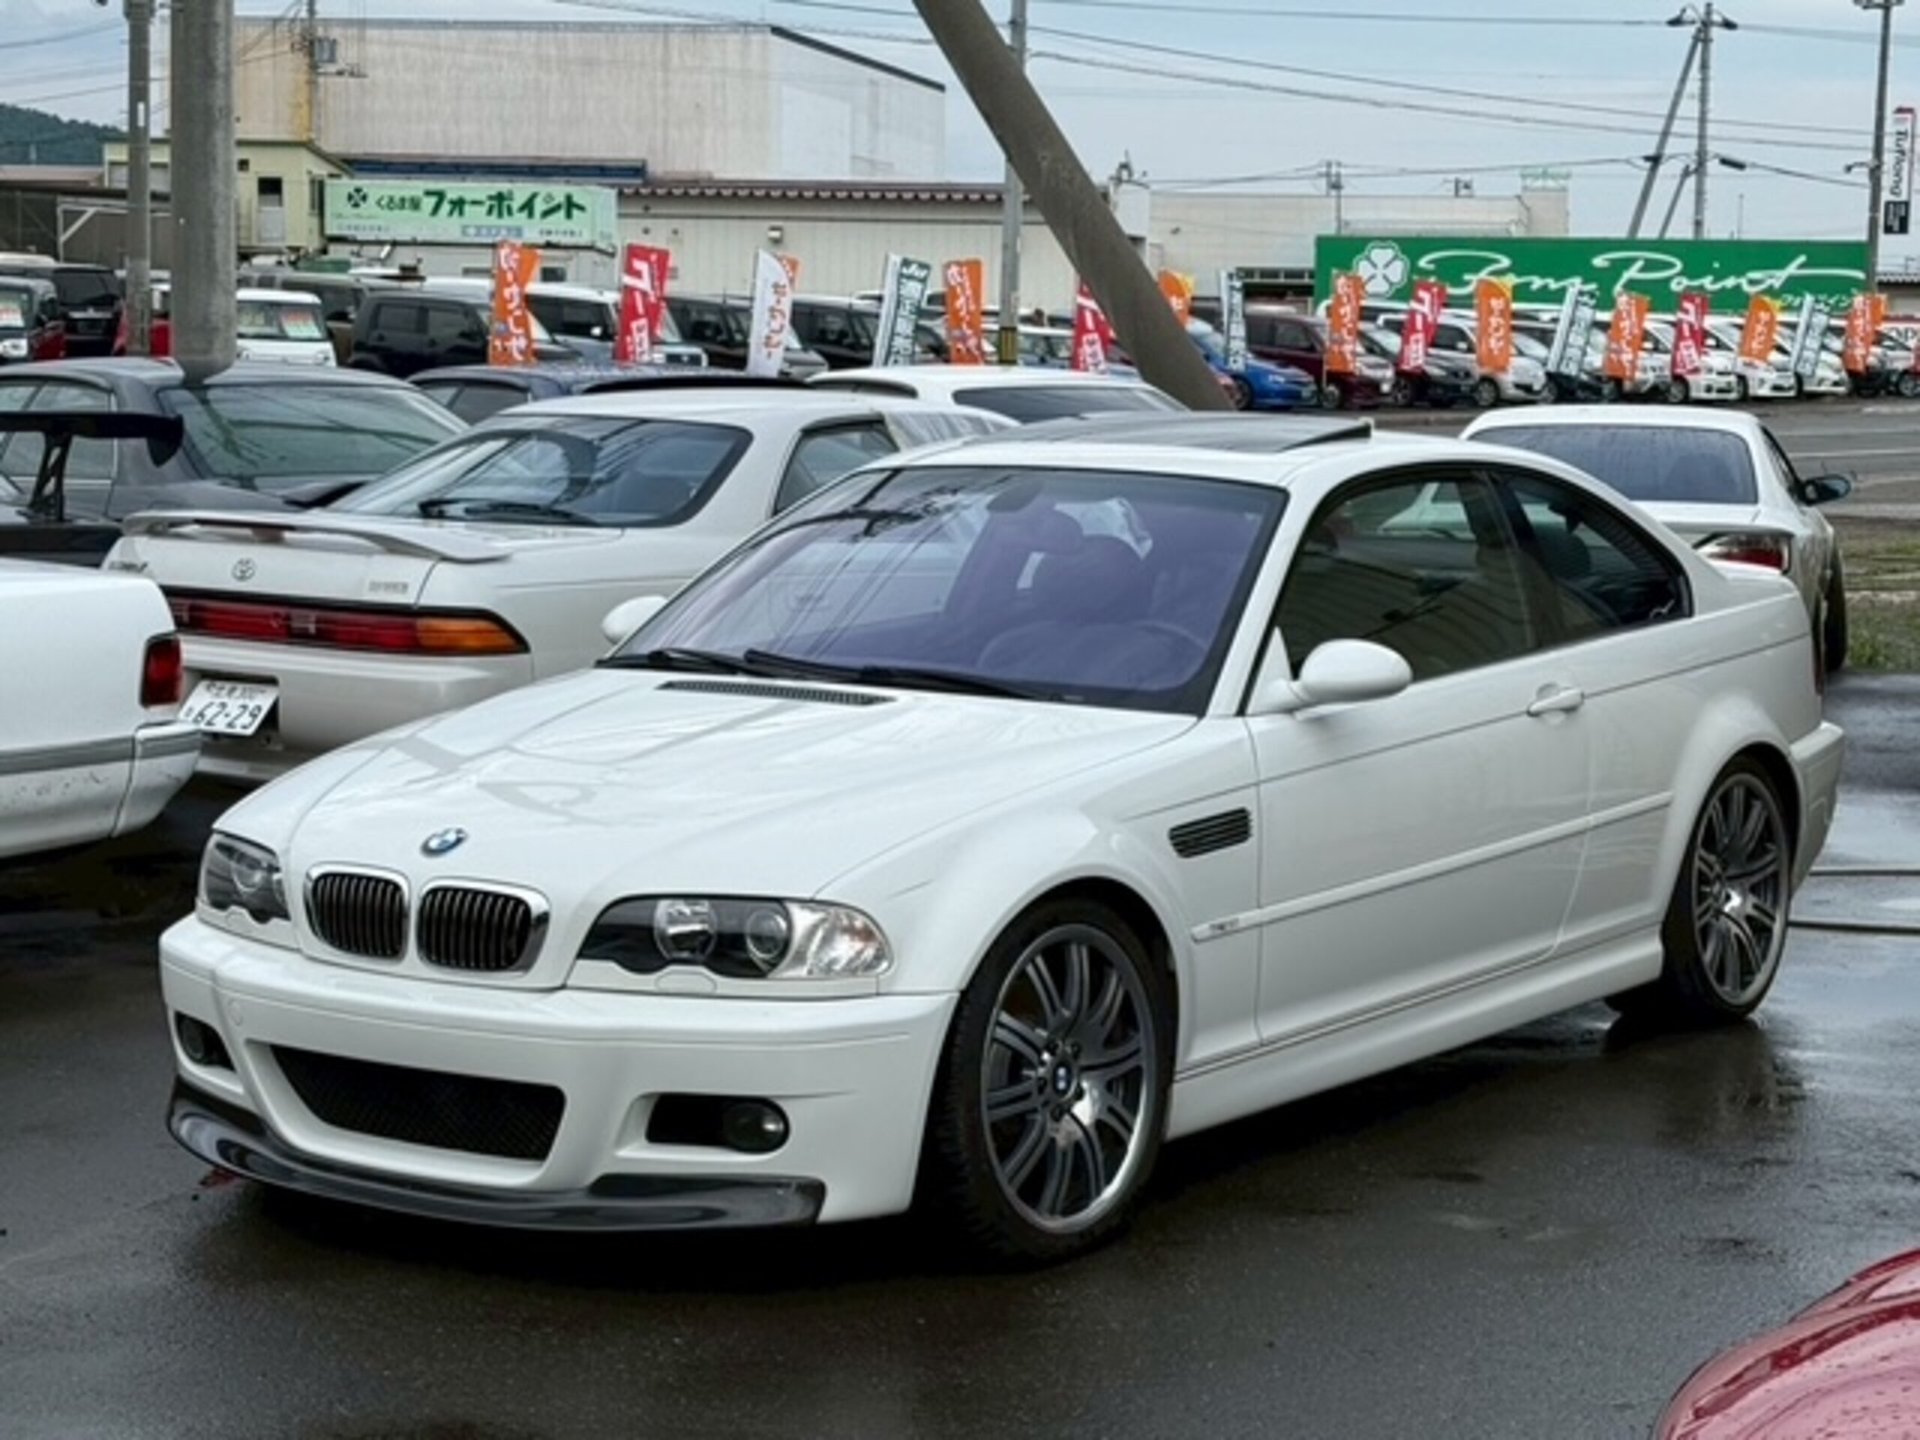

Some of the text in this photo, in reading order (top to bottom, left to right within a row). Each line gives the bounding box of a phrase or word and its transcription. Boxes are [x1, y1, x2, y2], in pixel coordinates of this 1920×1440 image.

[423, 188, 587, 219] フォーポイント
[1592, 250, 1866, 297] Point
[191, 701, 262, 730] 62-29
